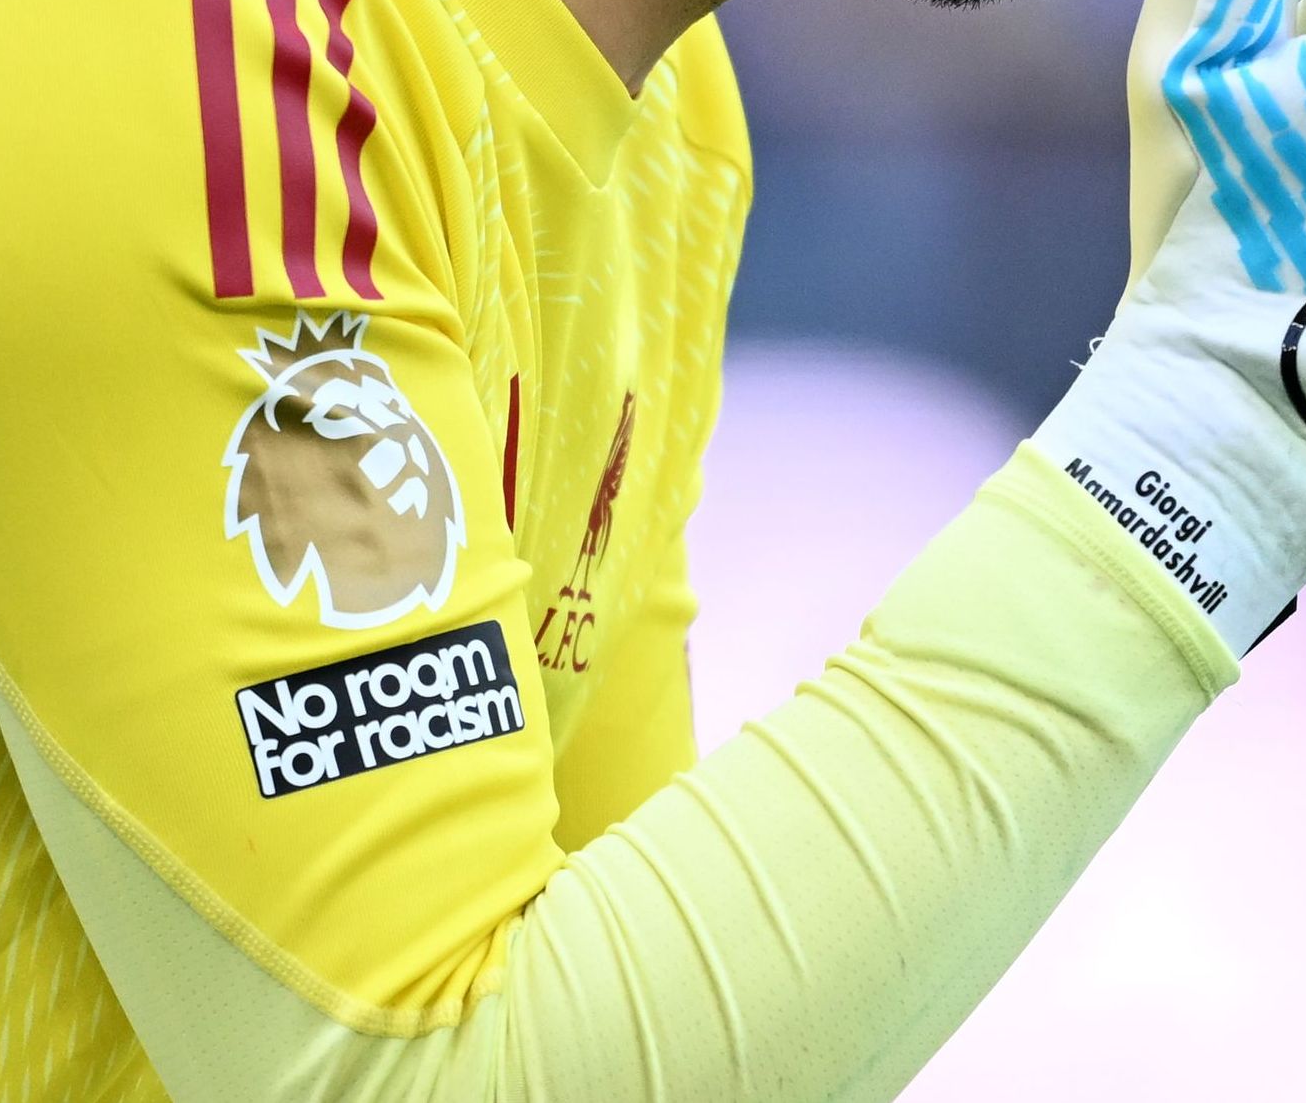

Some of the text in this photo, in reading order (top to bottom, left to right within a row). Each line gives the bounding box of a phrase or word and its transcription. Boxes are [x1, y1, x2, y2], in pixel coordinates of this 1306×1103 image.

[1064, 457, 1228, 615] Mamardashvili
[1135, 470, 1213, 544] Giorgi
[238, 639, 497, 745] No room
[254, 685, 524, 796] for racism
